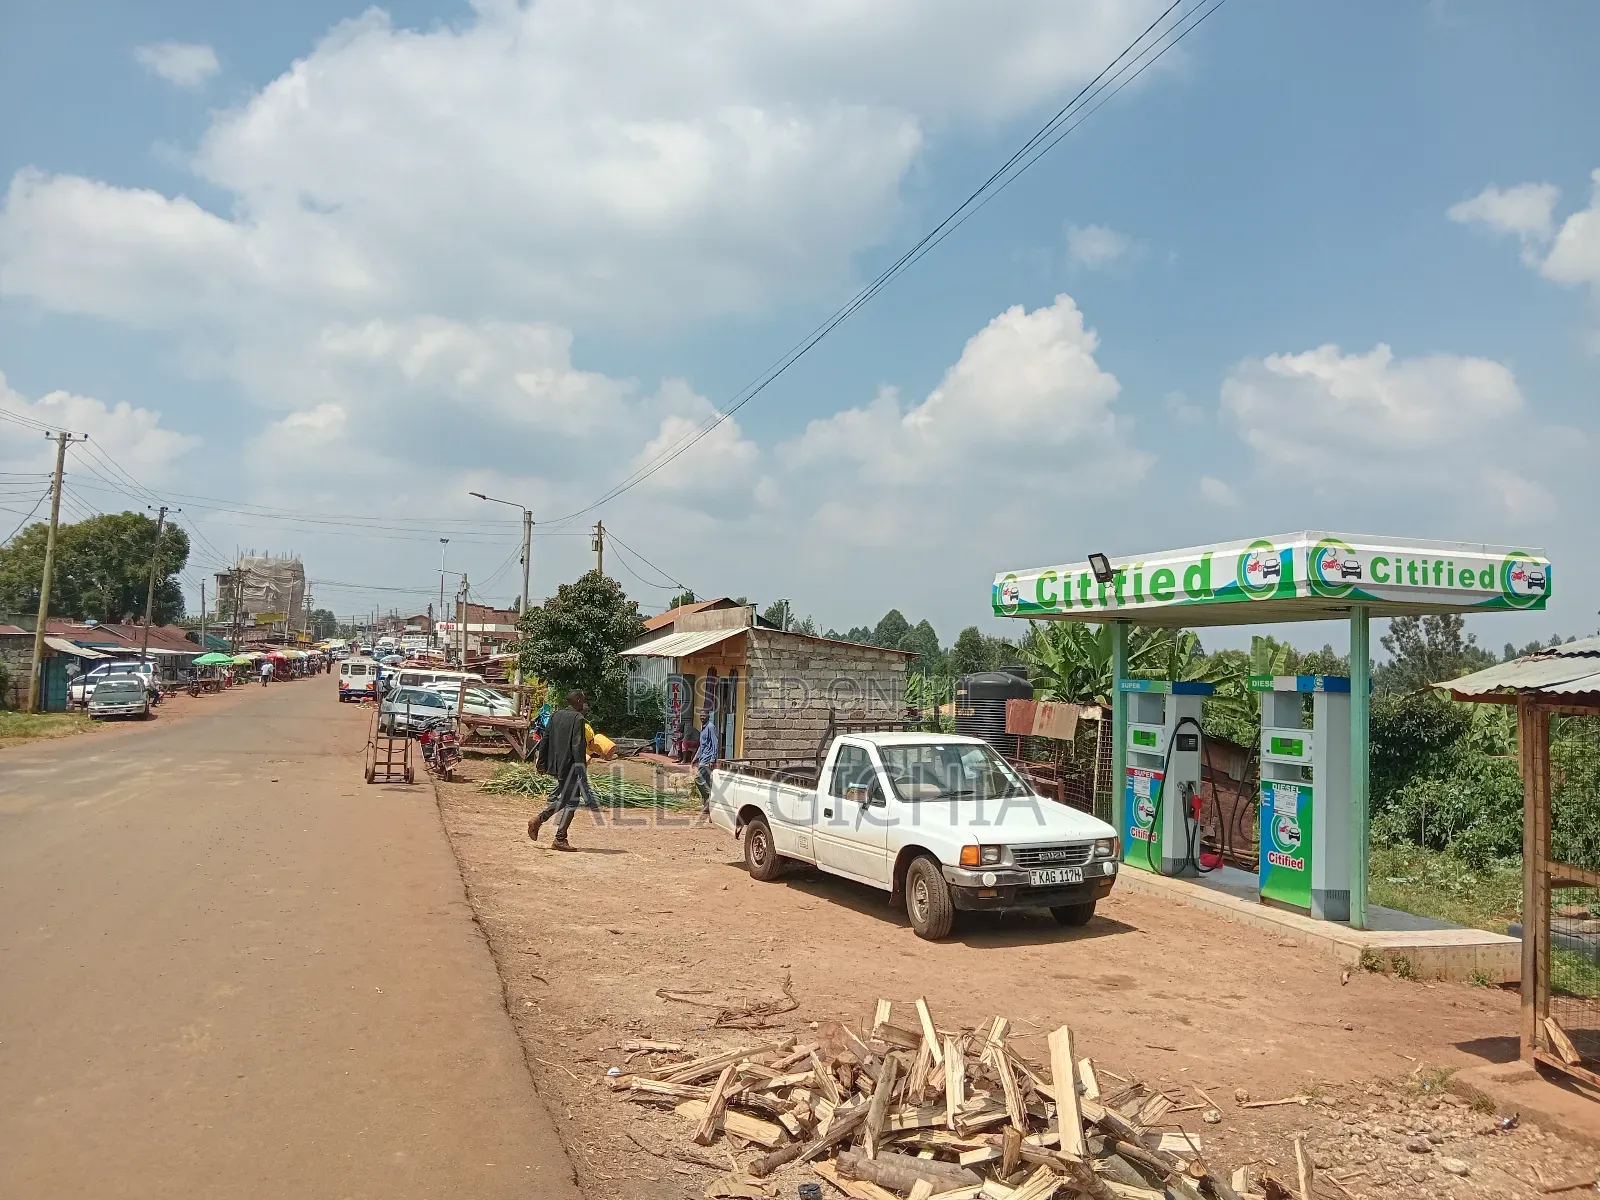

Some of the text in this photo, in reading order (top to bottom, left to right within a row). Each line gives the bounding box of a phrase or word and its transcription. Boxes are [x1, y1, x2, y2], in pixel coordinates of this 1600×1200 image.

[1036, 551, 1215, 610] Citified
[1370, 556, 1495, 590] Citified
[1134, 770, 1154, 779] SUPER
[1272, 783, 1301, 794] DIESEL
[1130, 827, 1157, 842] Citifid
[1039, 851, 1066, 860] ISUZU
[1268, 852, 1303, 869] Citified
[1039, 870, 1056, 884] KAG
[1059, 868, 1081, 882] 117H
